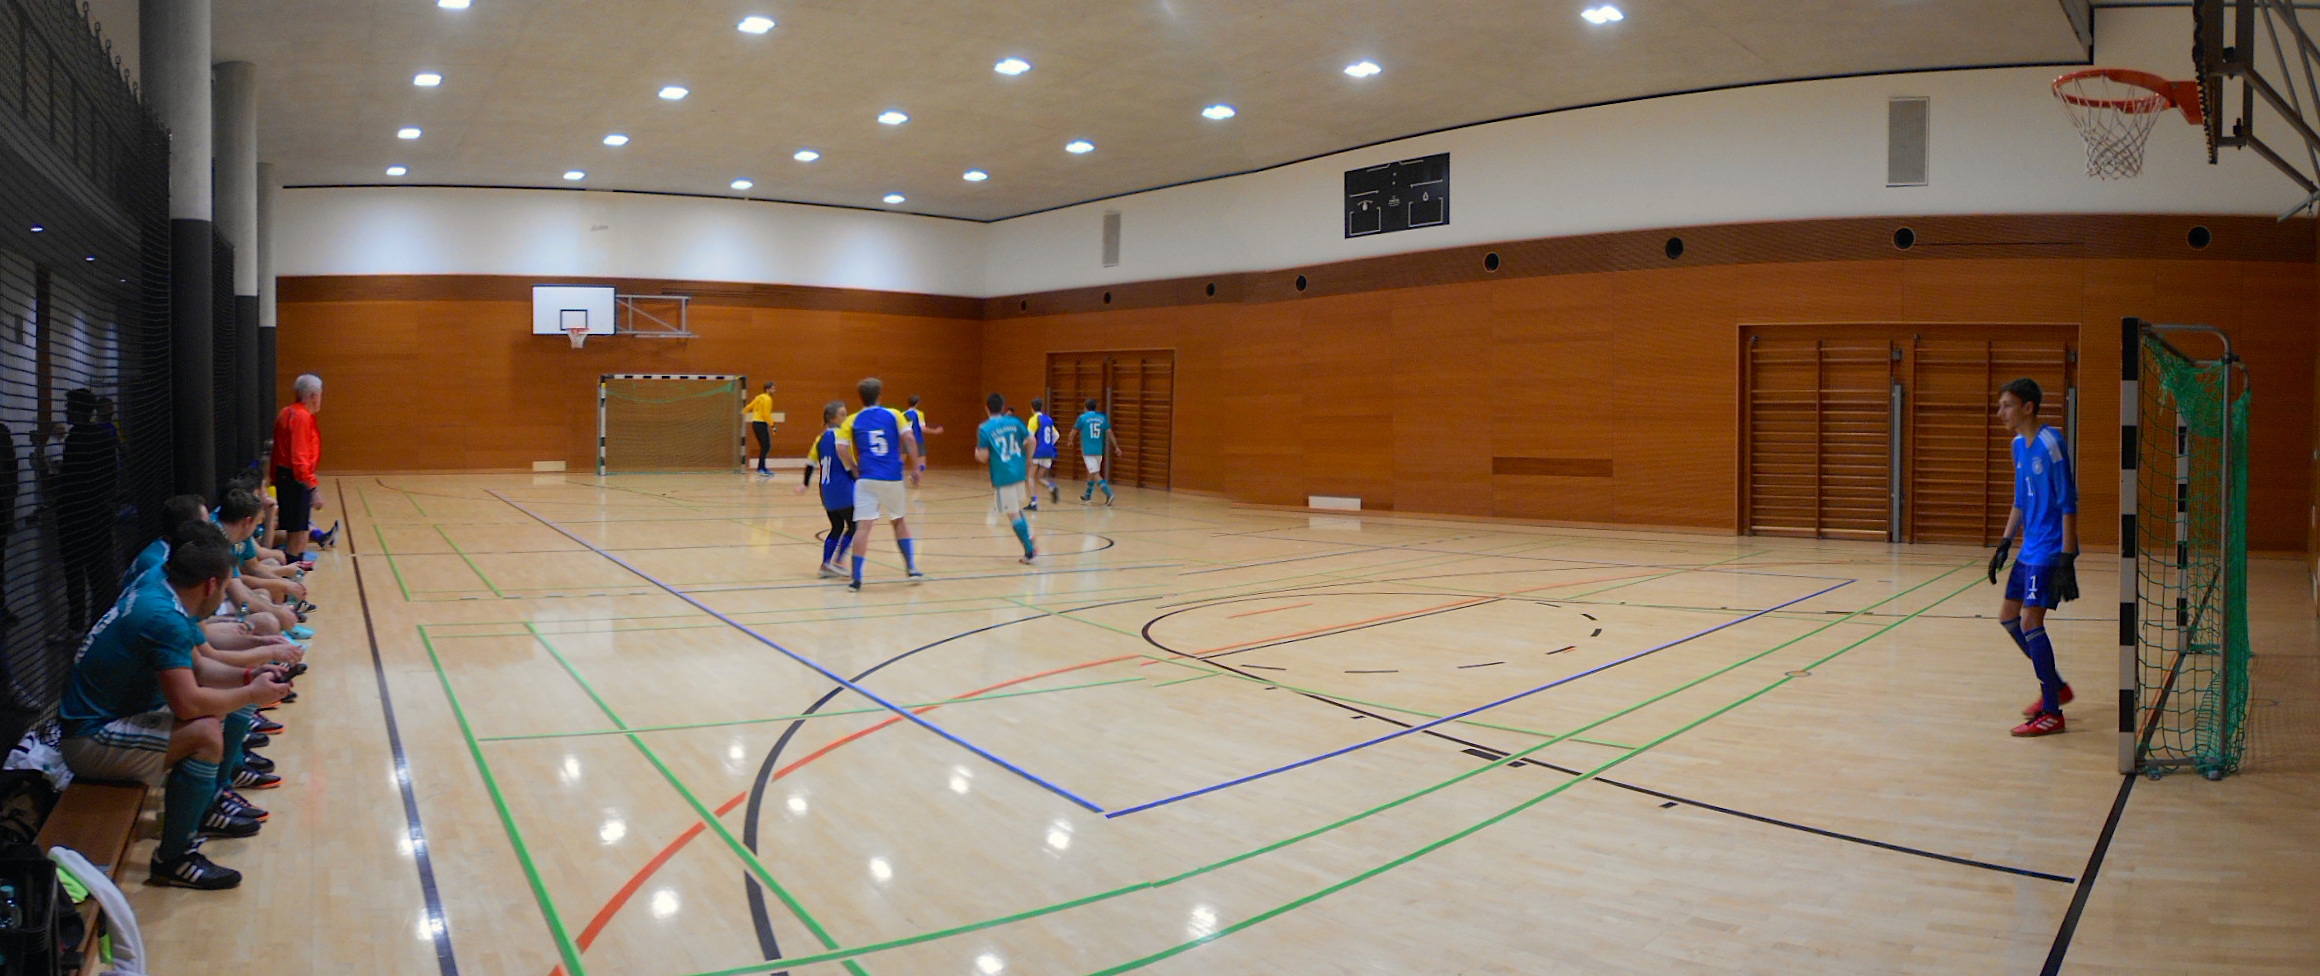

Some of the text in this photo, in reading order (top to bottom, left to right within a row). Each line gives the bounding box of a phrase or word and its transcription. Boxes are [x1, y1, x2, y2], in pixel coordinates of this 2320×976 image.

[1044, 425, 1051, 444] 6
[1090, 421, 1103, 439] 15
[868, 430, 889, 456] 5
[993, 432, 1022, 463] 24
[2025, 476, 2034, 496] 1
[2028, 575, 2038, 592] 1
